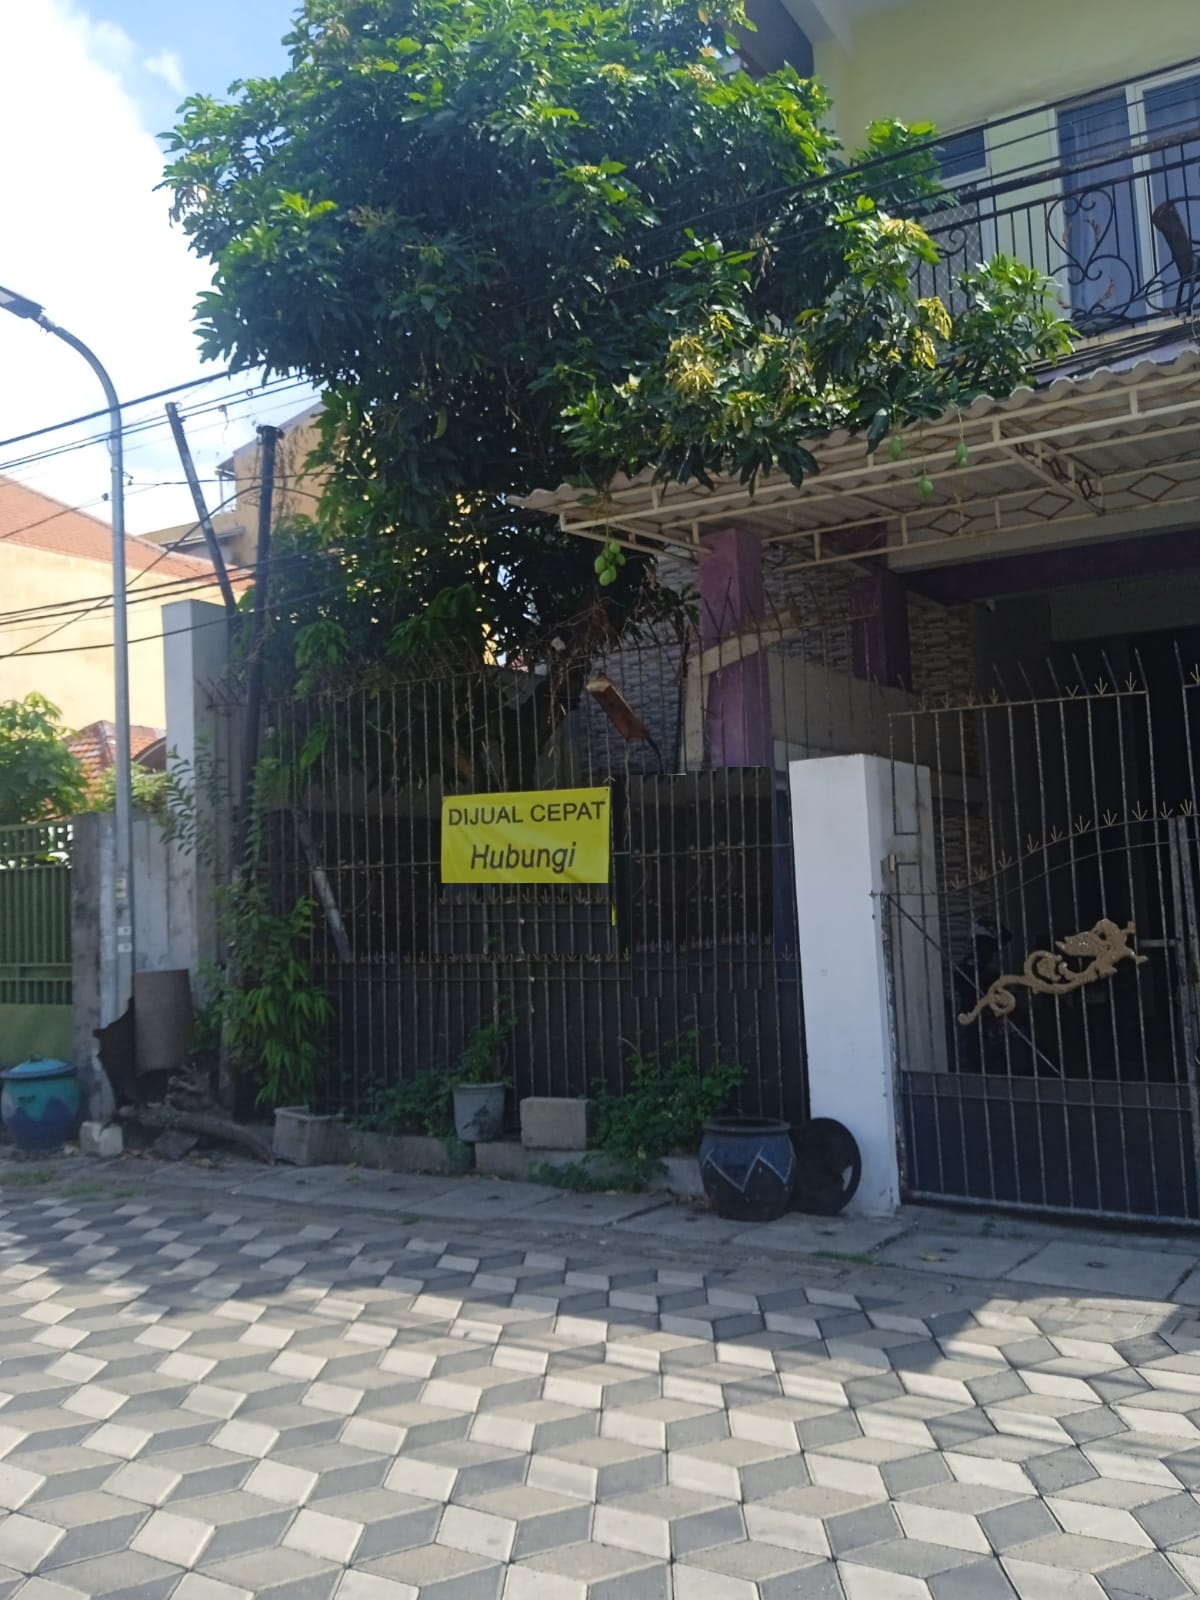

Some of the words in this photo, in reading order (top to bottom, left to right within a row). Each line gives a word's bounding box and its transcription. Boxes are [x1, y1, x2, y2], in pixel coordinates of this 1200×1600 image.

[448, 805, 523, 826] DIJUAL
[530, 801, 606, 822] CEPAT
[470, 841, 577, 874] Hubungi
